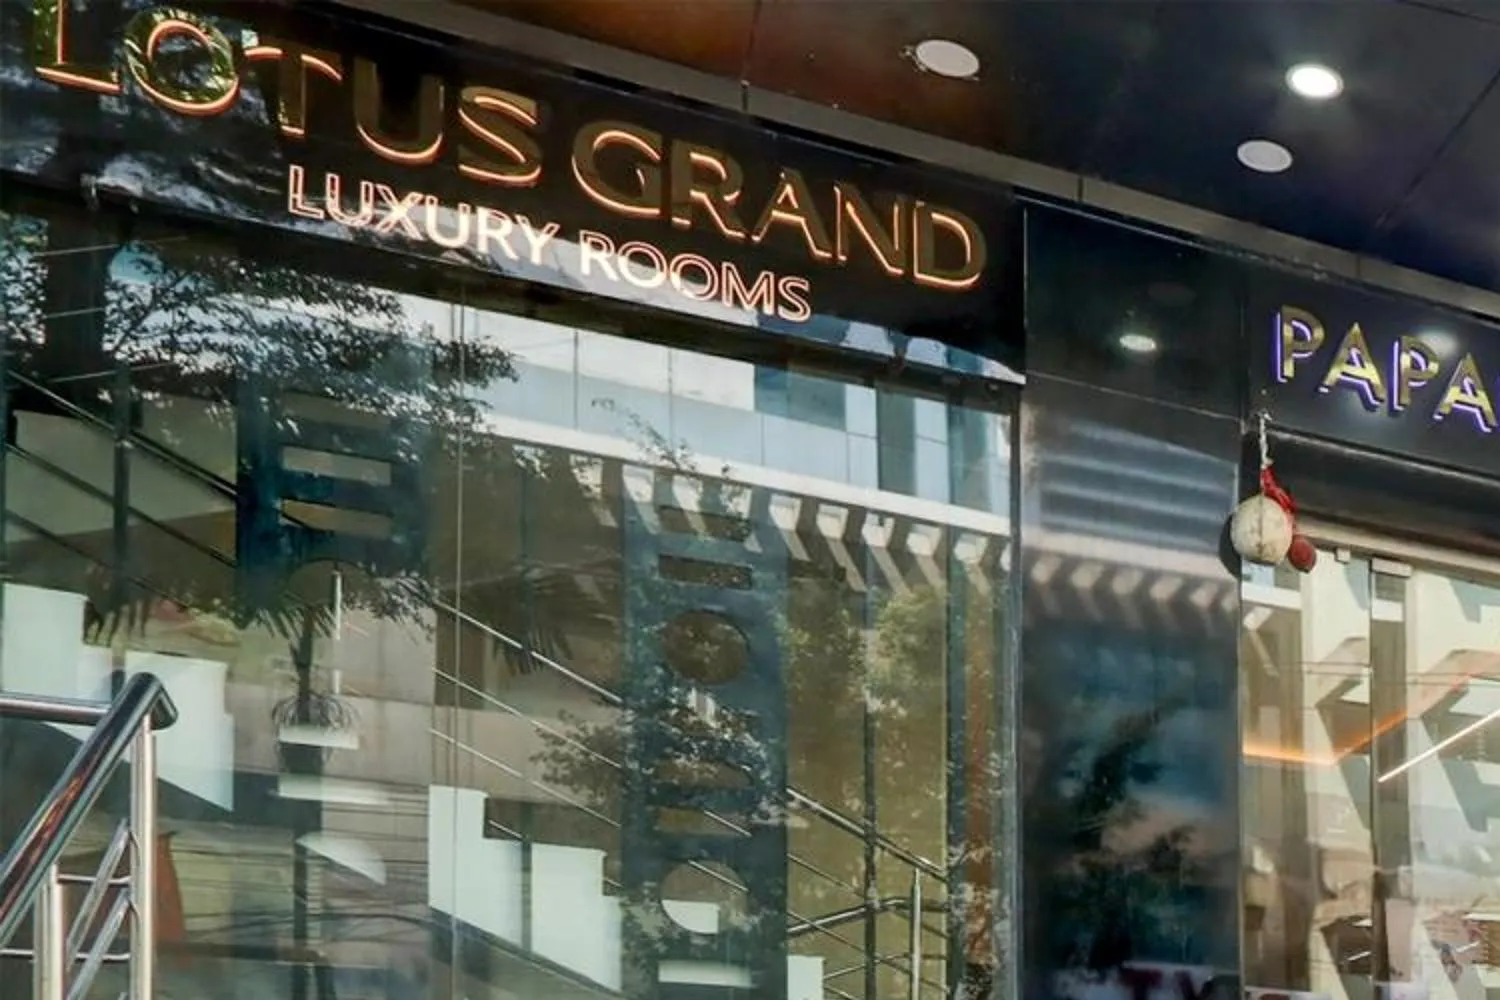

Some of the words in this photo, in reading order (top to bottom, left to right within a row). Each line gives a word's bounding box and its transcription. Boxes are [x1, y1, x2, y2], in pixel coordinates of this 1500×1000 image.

[33, 0, 542, 187] LOTUS
[570, 120, 986, 288] GRAND
[286, 164, 562, 266] LUXURY
[578, 229, 813, 323] ROOMS
